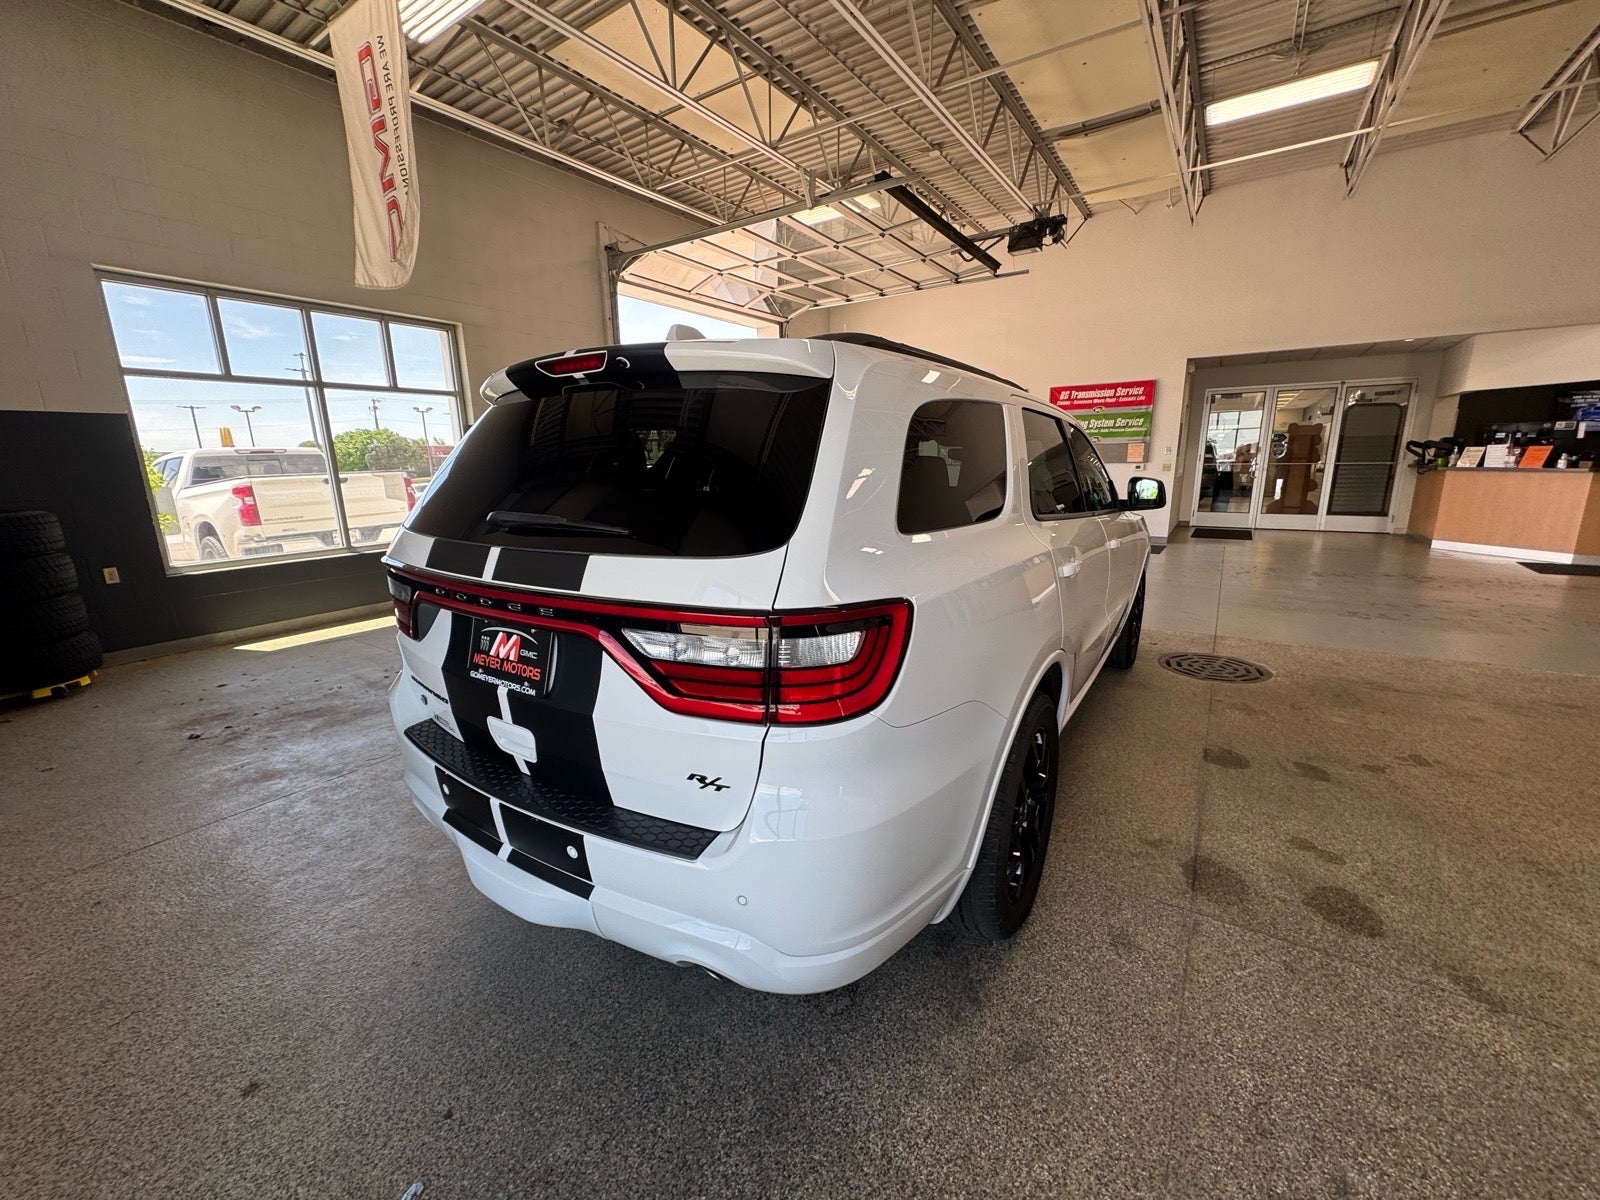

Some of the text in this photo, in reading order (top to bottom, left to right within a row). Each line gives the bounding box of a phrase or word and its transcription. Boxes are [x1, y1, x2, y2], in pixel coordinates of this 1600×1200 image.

[1071, 388, 1115, 400] Transmission
[1116, 386, 1144, 396] Service
[1089, 418, 1114, 429] System
[1116, 417, 1144, 426] Service
[435, 587, 554, 616] DODGE
[520, 649, 538, 660] GMC
[473, 653, 541, 681] MEYER MOTORS
[469, 670, 536, 697] GOMEYERMOTORS.COM
[686, 773, 731, 792] R/T
